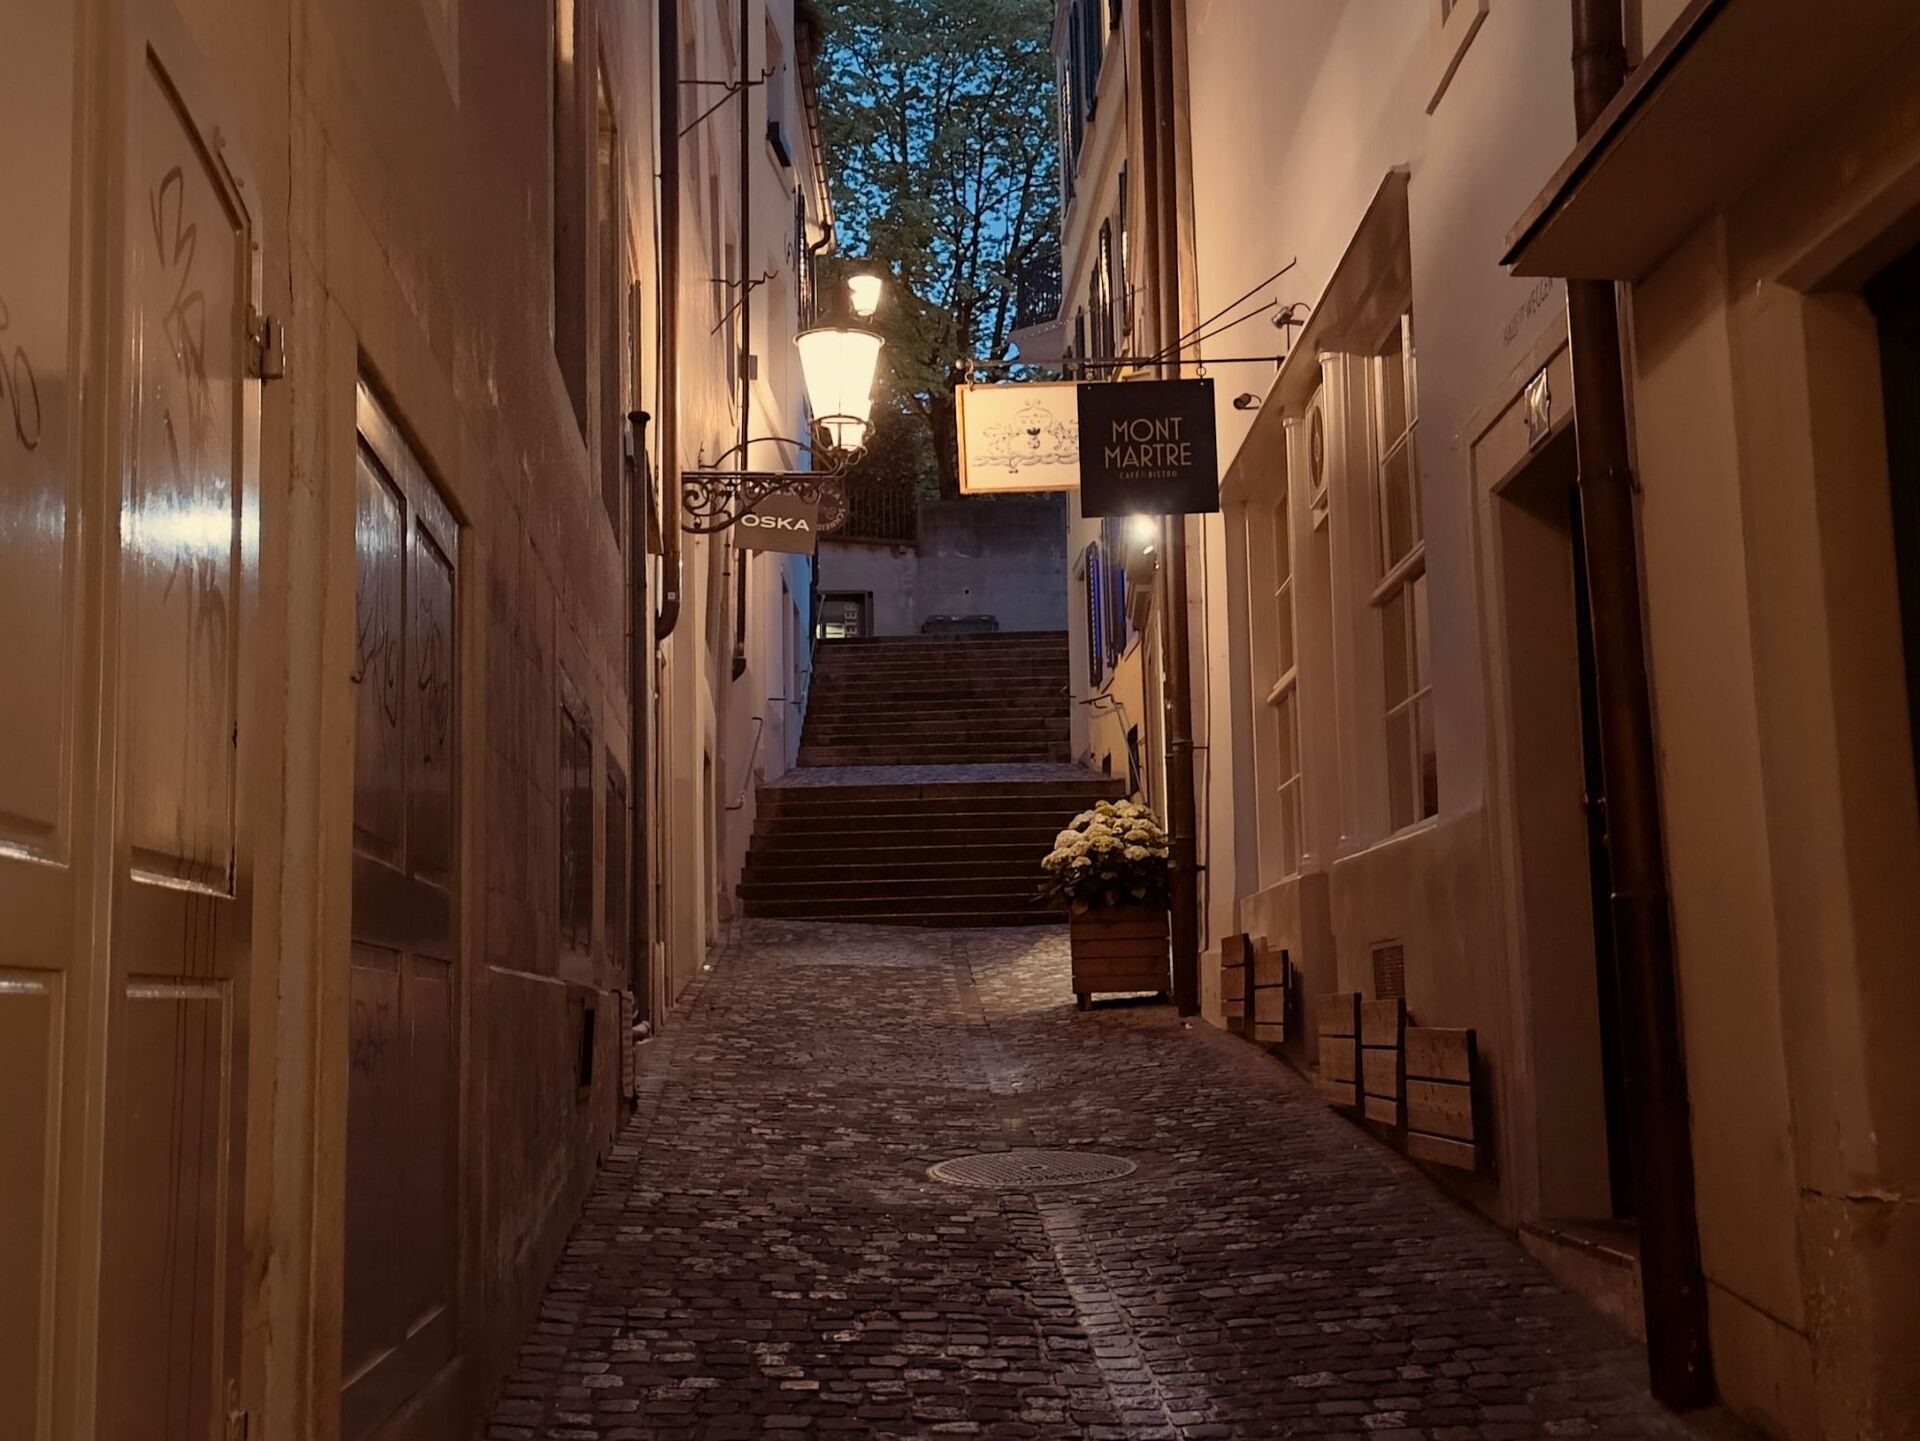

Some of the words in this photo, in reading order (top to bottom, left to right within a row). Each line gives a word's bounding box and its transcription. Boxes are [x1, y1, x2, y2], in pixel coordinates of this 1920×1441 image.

[1112, 416, 1183, 443] MONT
[1104, 442, 1192, 469] MARTRE
[740, 513, 811, 532] OSKA
